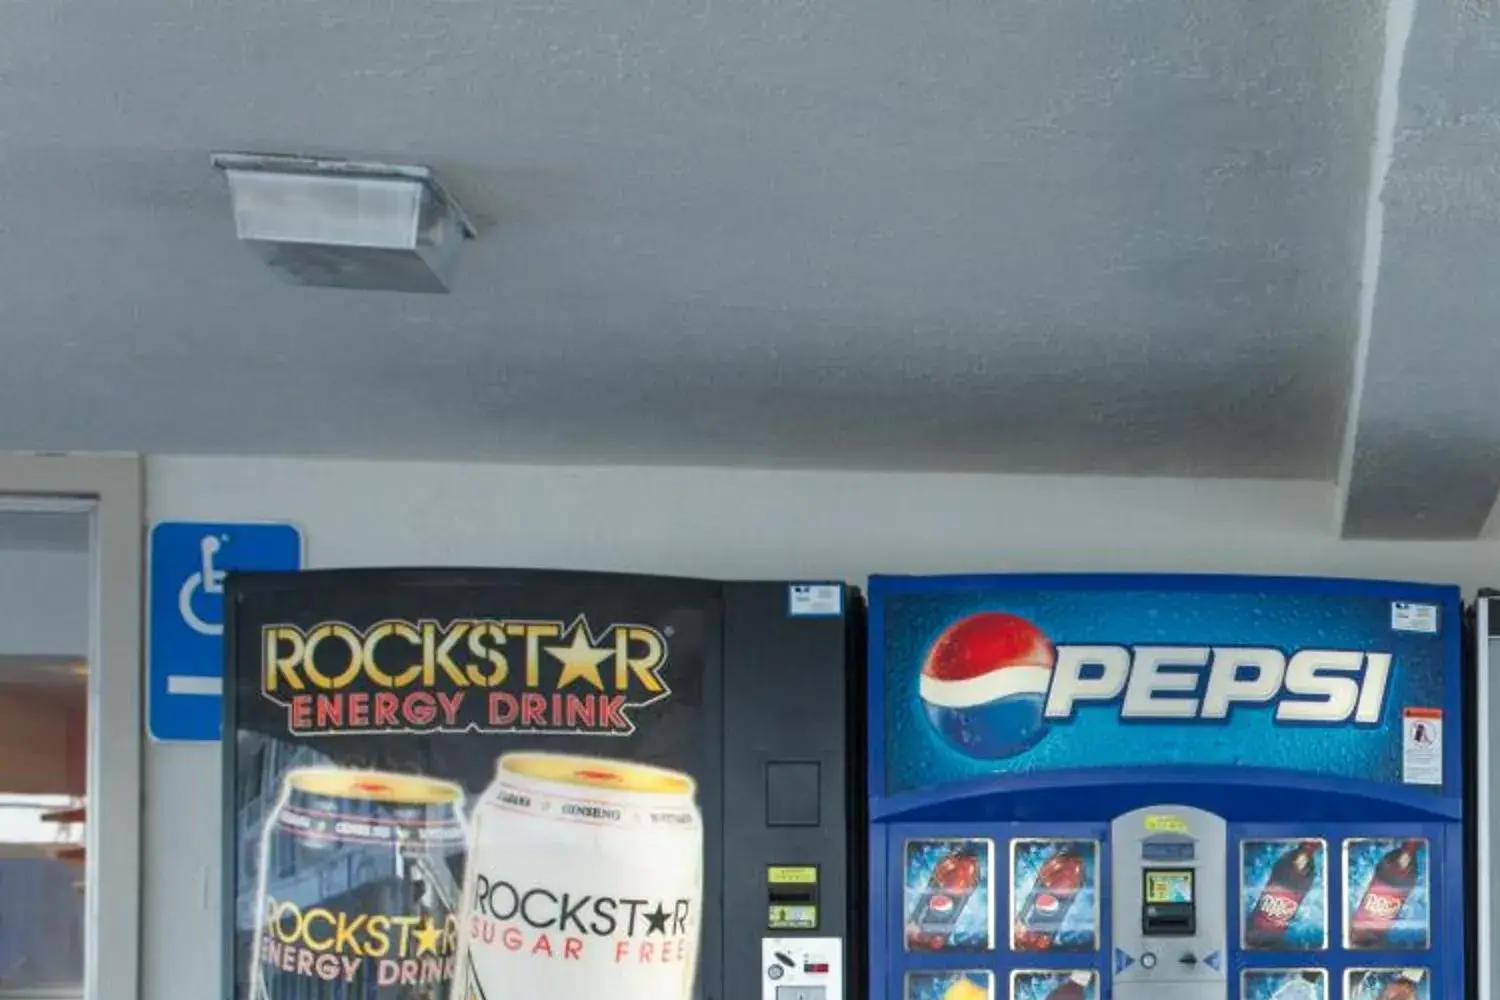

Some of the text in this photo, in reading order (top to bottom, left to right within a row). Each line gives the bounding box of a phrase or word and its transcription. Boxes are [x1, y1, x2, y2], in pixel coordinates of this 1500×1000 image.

[1045, 645, 1392, 724] PEPSI
[292, 691, 630, 729] ENERGY DRINK
[471, 916, 687, 964] SUGAR FREE
